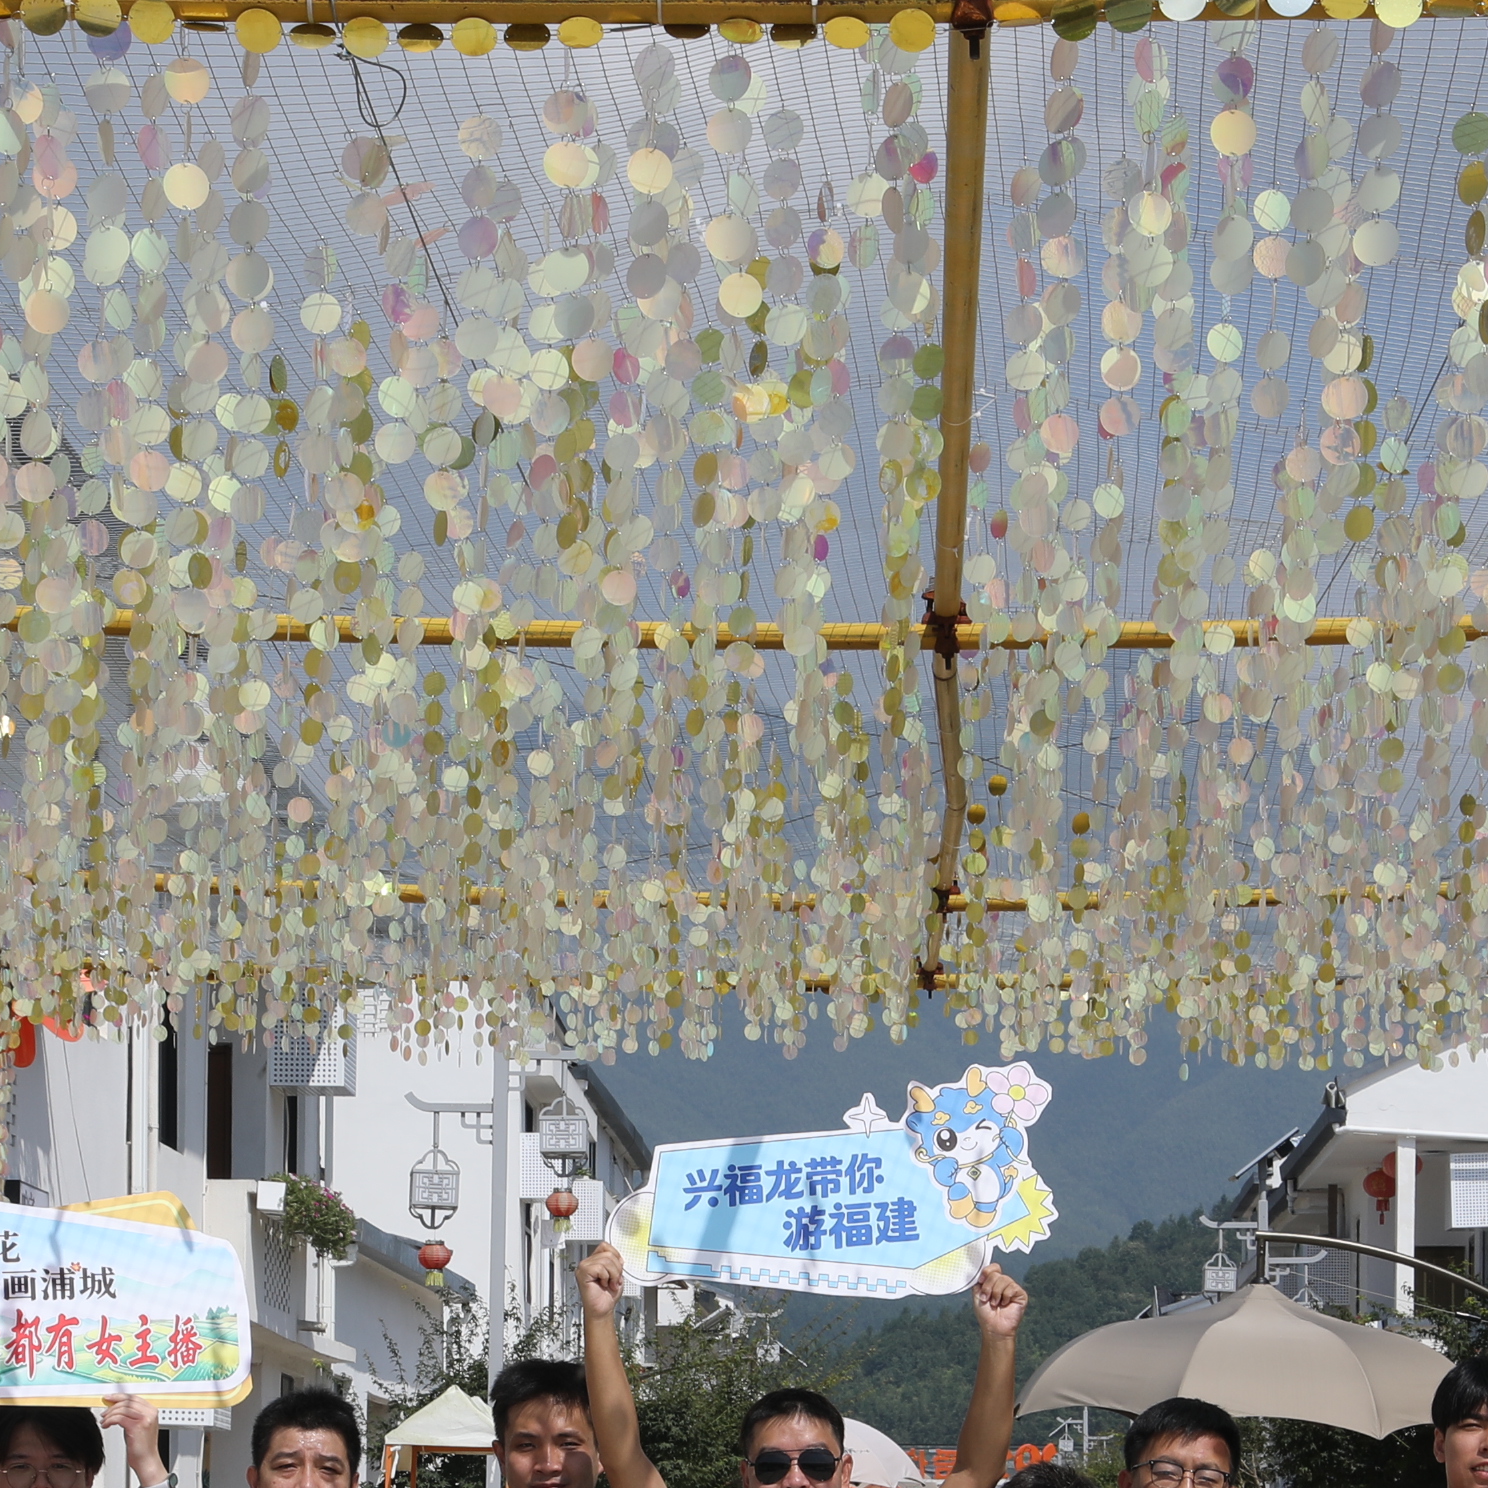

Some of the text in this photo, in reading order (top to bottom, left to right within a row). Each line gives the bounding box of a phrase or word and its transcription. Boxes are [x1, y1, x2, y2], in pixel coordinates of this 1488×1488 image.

[682, 1153, 885, 1212] 兴福龙带你
[782, 1197, 920, 1252] 游福建
